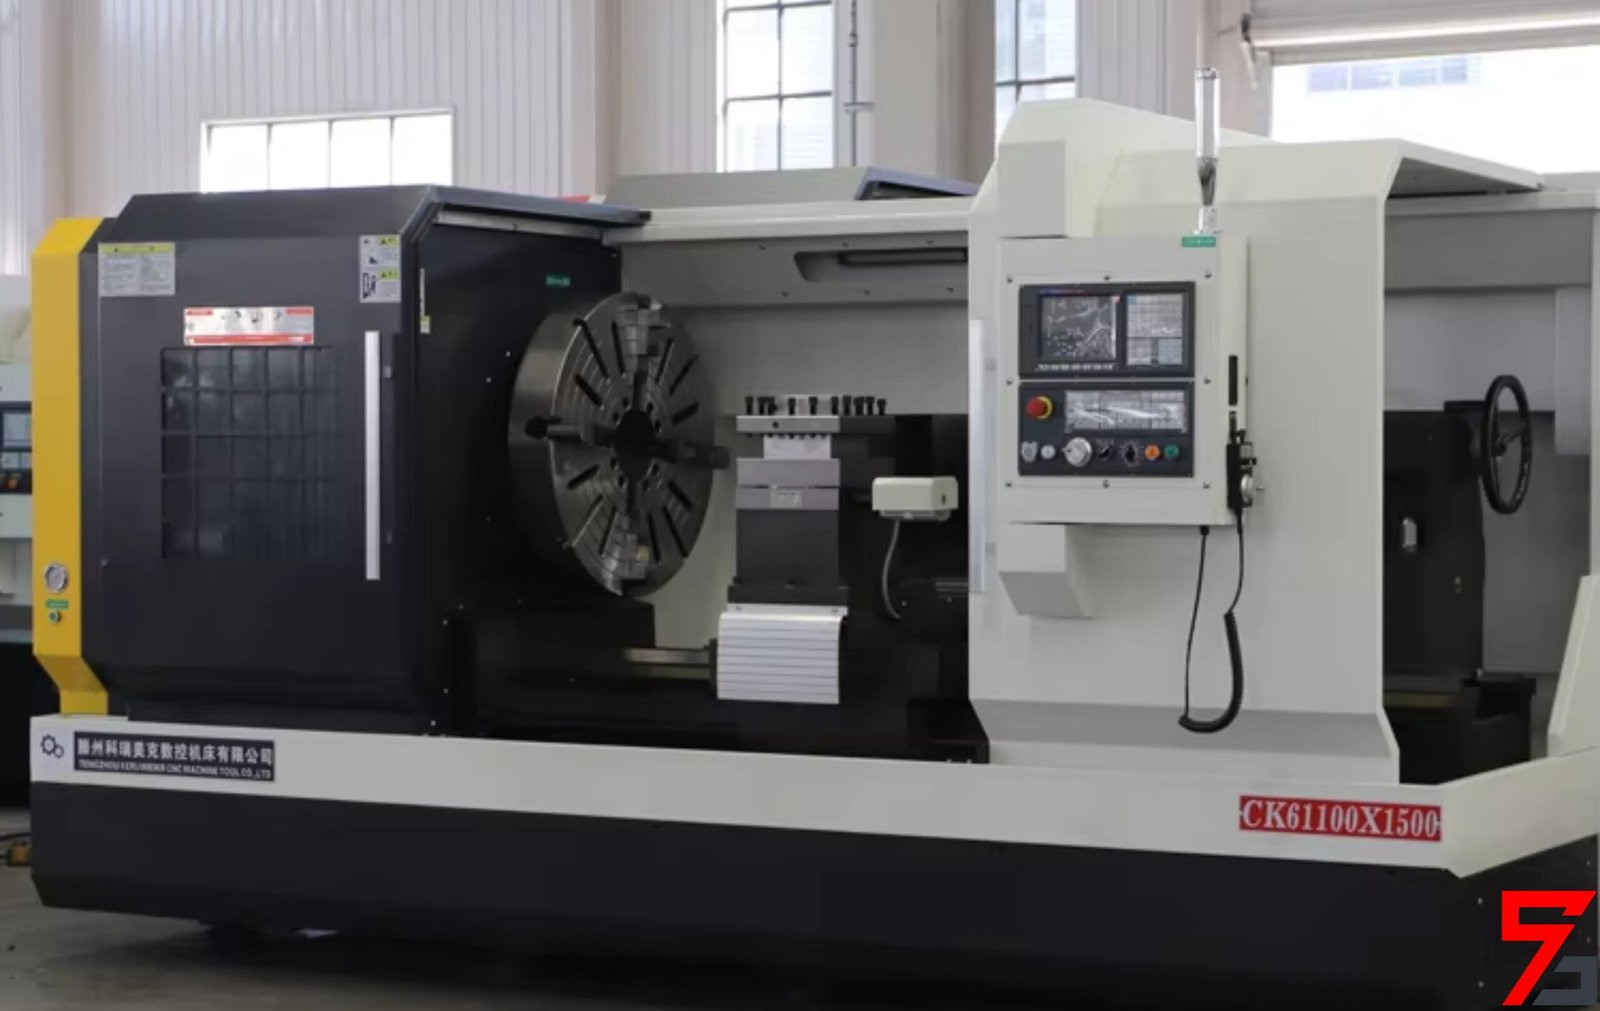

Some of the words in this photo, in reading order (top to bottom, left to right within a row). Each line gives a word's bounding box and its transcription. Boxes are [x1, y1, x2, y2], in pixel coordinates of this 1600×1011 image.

[166, 763, 181, 773] CNC
[183, 764, 218, 775] MACHINE
[219, 767, 239, 777] TOOL
[1243, 799, 1437, 838] CK61100X1500
